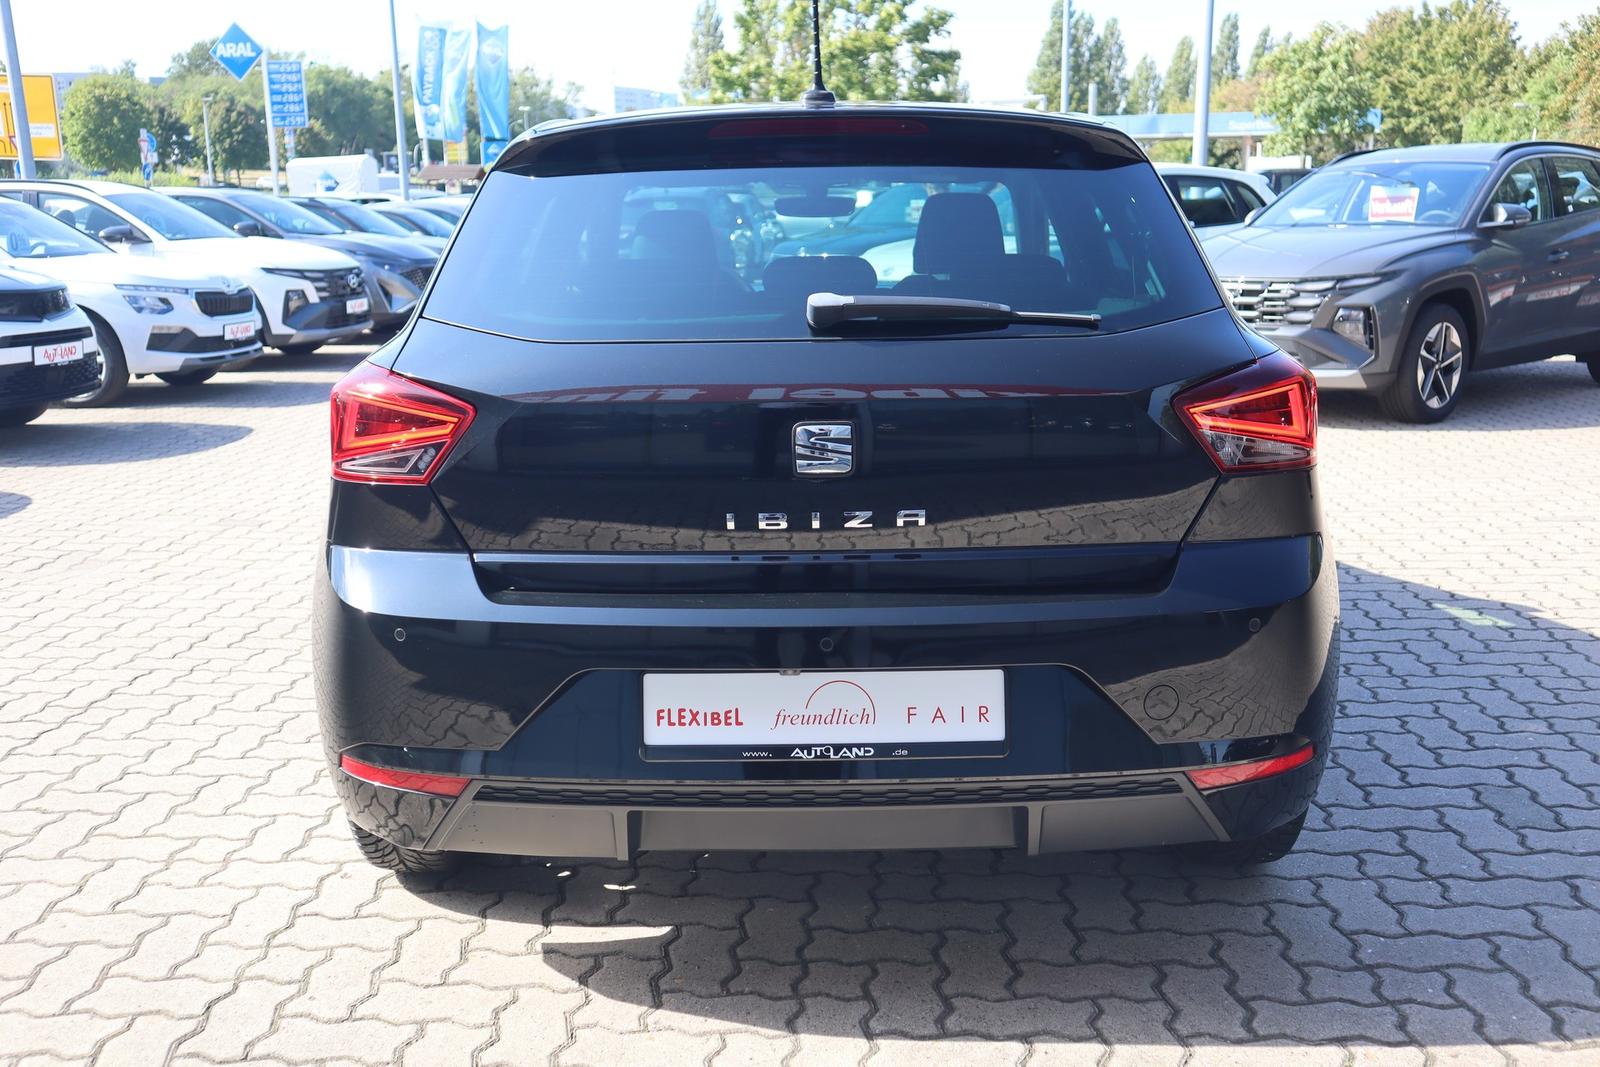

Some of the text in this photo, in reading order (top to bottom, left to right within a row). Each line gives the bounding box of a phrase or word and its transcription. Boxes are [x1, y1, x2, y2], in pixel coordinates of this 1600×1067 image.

[216, 42, 256, 58] ARAL
[422, 49, 435, 103] PAYBACK
[726, 509, 926, 530] IBIZA
[656, 705, 990, 731] FLEXIBEL freundlich FAIR
[790, 745, 875, 760] AUTOLAND
